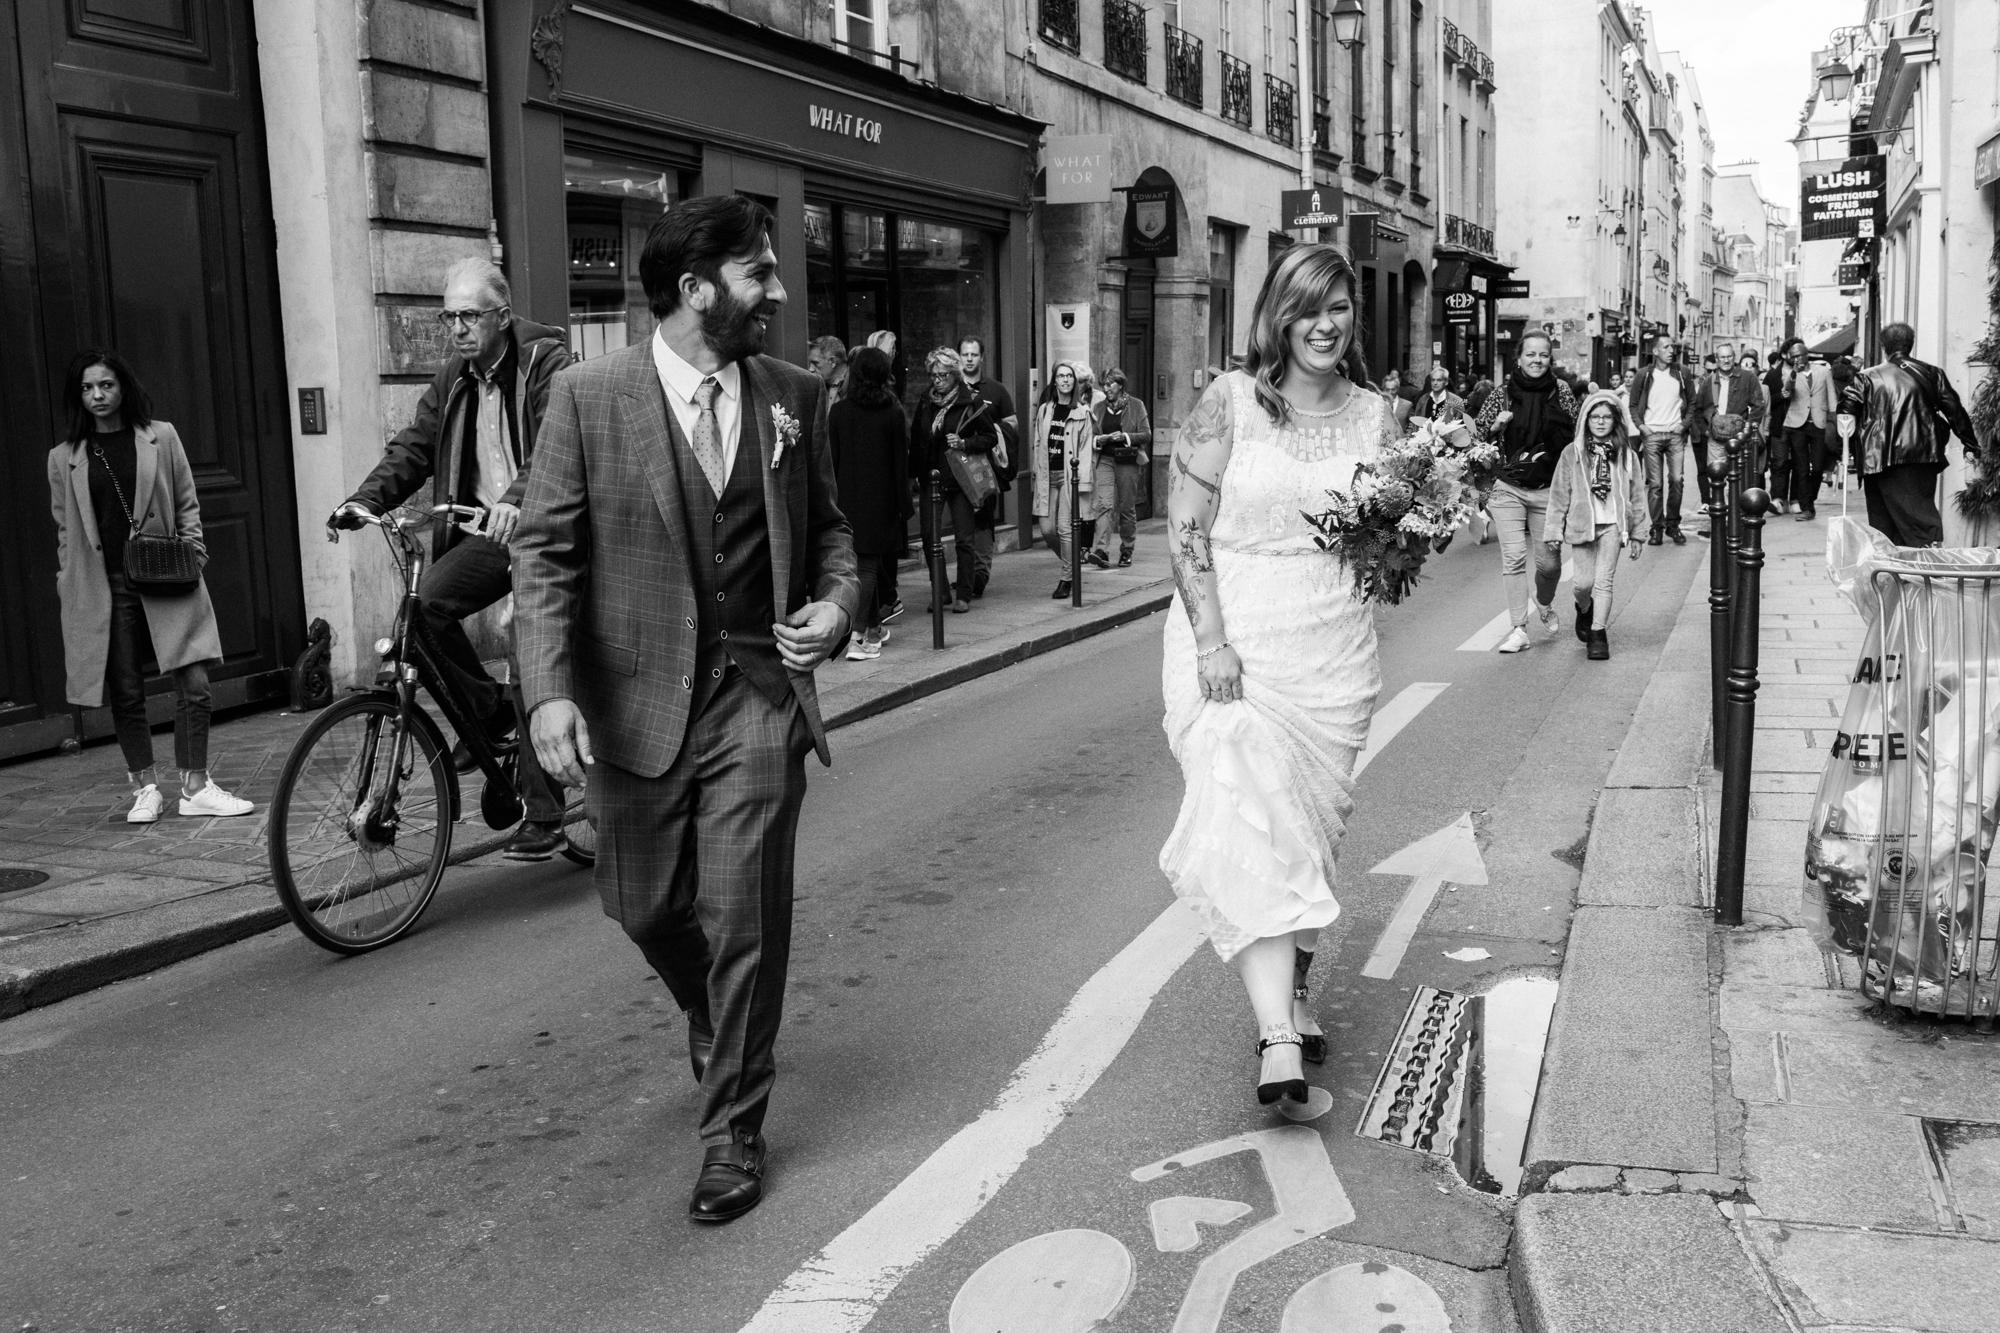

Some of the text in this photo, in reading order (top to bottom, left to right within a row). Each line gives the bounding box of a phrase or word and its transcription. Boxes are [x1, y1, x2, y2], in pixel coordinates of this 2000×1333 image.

[809, 104, 882, 144] WHAT FOR
[1054, 155, 1101, 167] WHAT
[1062, 171, 1092, 184] FOR
[1817, 171, 1870, 189] LUSH
[1132, 191, 1169, 201] EDWART
[1808, 190, 1879, 204] COSMETIQUES
[1827, 201, 1859, 211] FRAIS
[1814, 207, 1873, 220] FAITS MAIN
